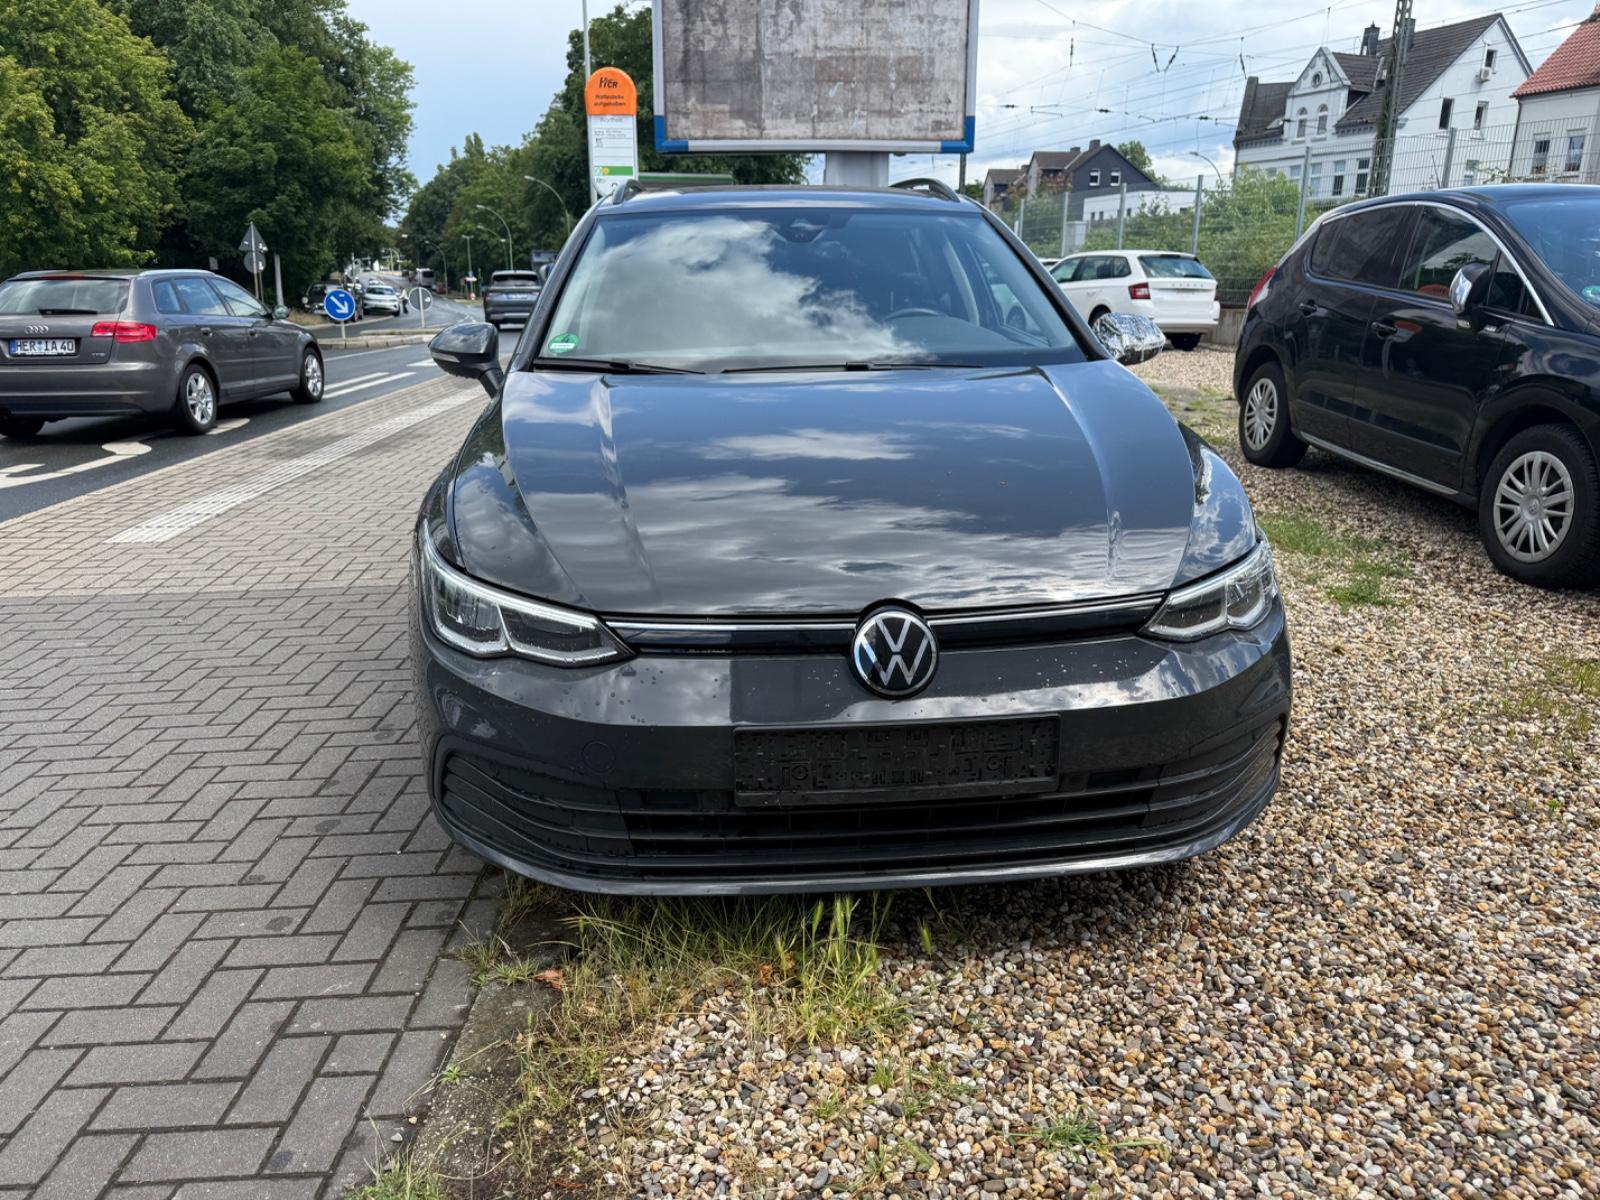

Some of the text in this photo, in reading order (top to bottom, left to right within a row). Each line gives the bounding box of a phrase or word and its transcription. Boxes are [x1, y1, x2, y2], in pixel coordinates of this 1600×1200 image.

[16, 340, 74, 351] HER IA 40
[858, 613, 932, 688] VW
